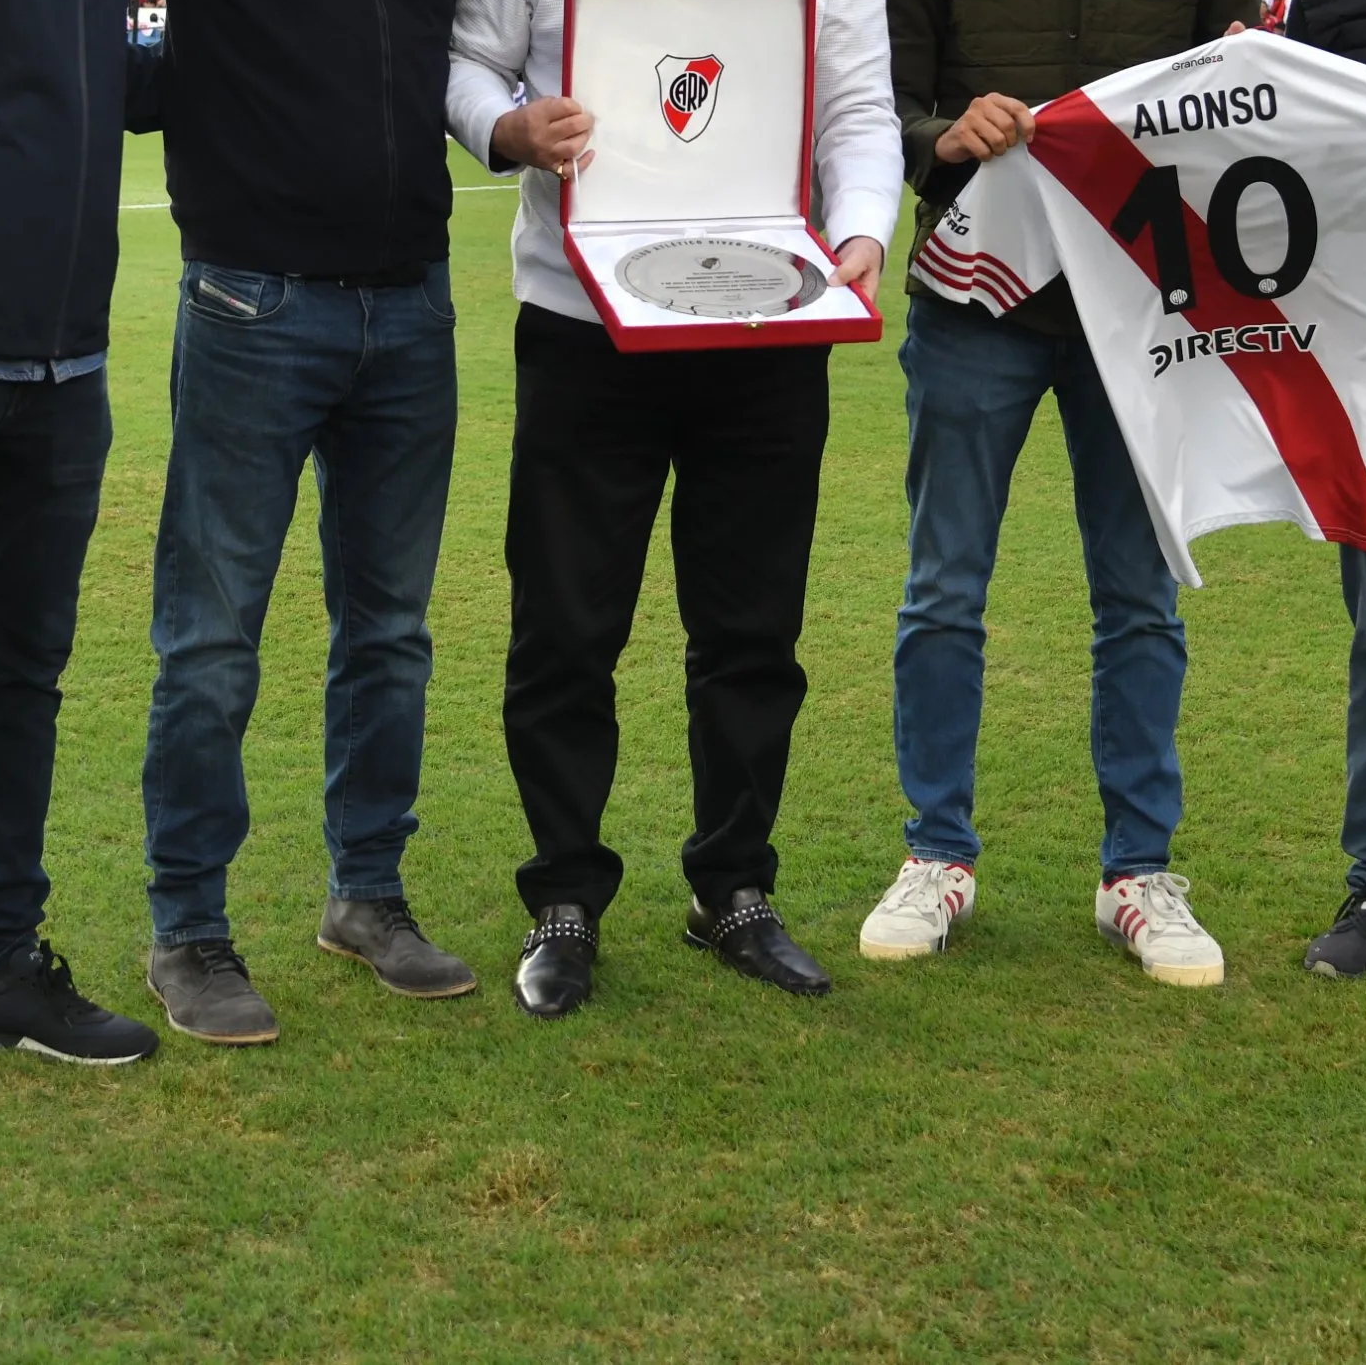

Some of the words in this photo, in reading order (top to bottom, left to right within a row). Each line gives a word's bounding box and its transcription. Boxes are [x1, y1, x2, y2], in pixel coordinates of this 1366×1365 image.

[1171, 54, 1224, 71] Grandeza
[669, 72, 709, 112] CARP
[1131, 83, 1278, 139] ALONSO
[1110, 156, 1318, 315] 10
[1148, 324, 1317, 378] DIRECTV
